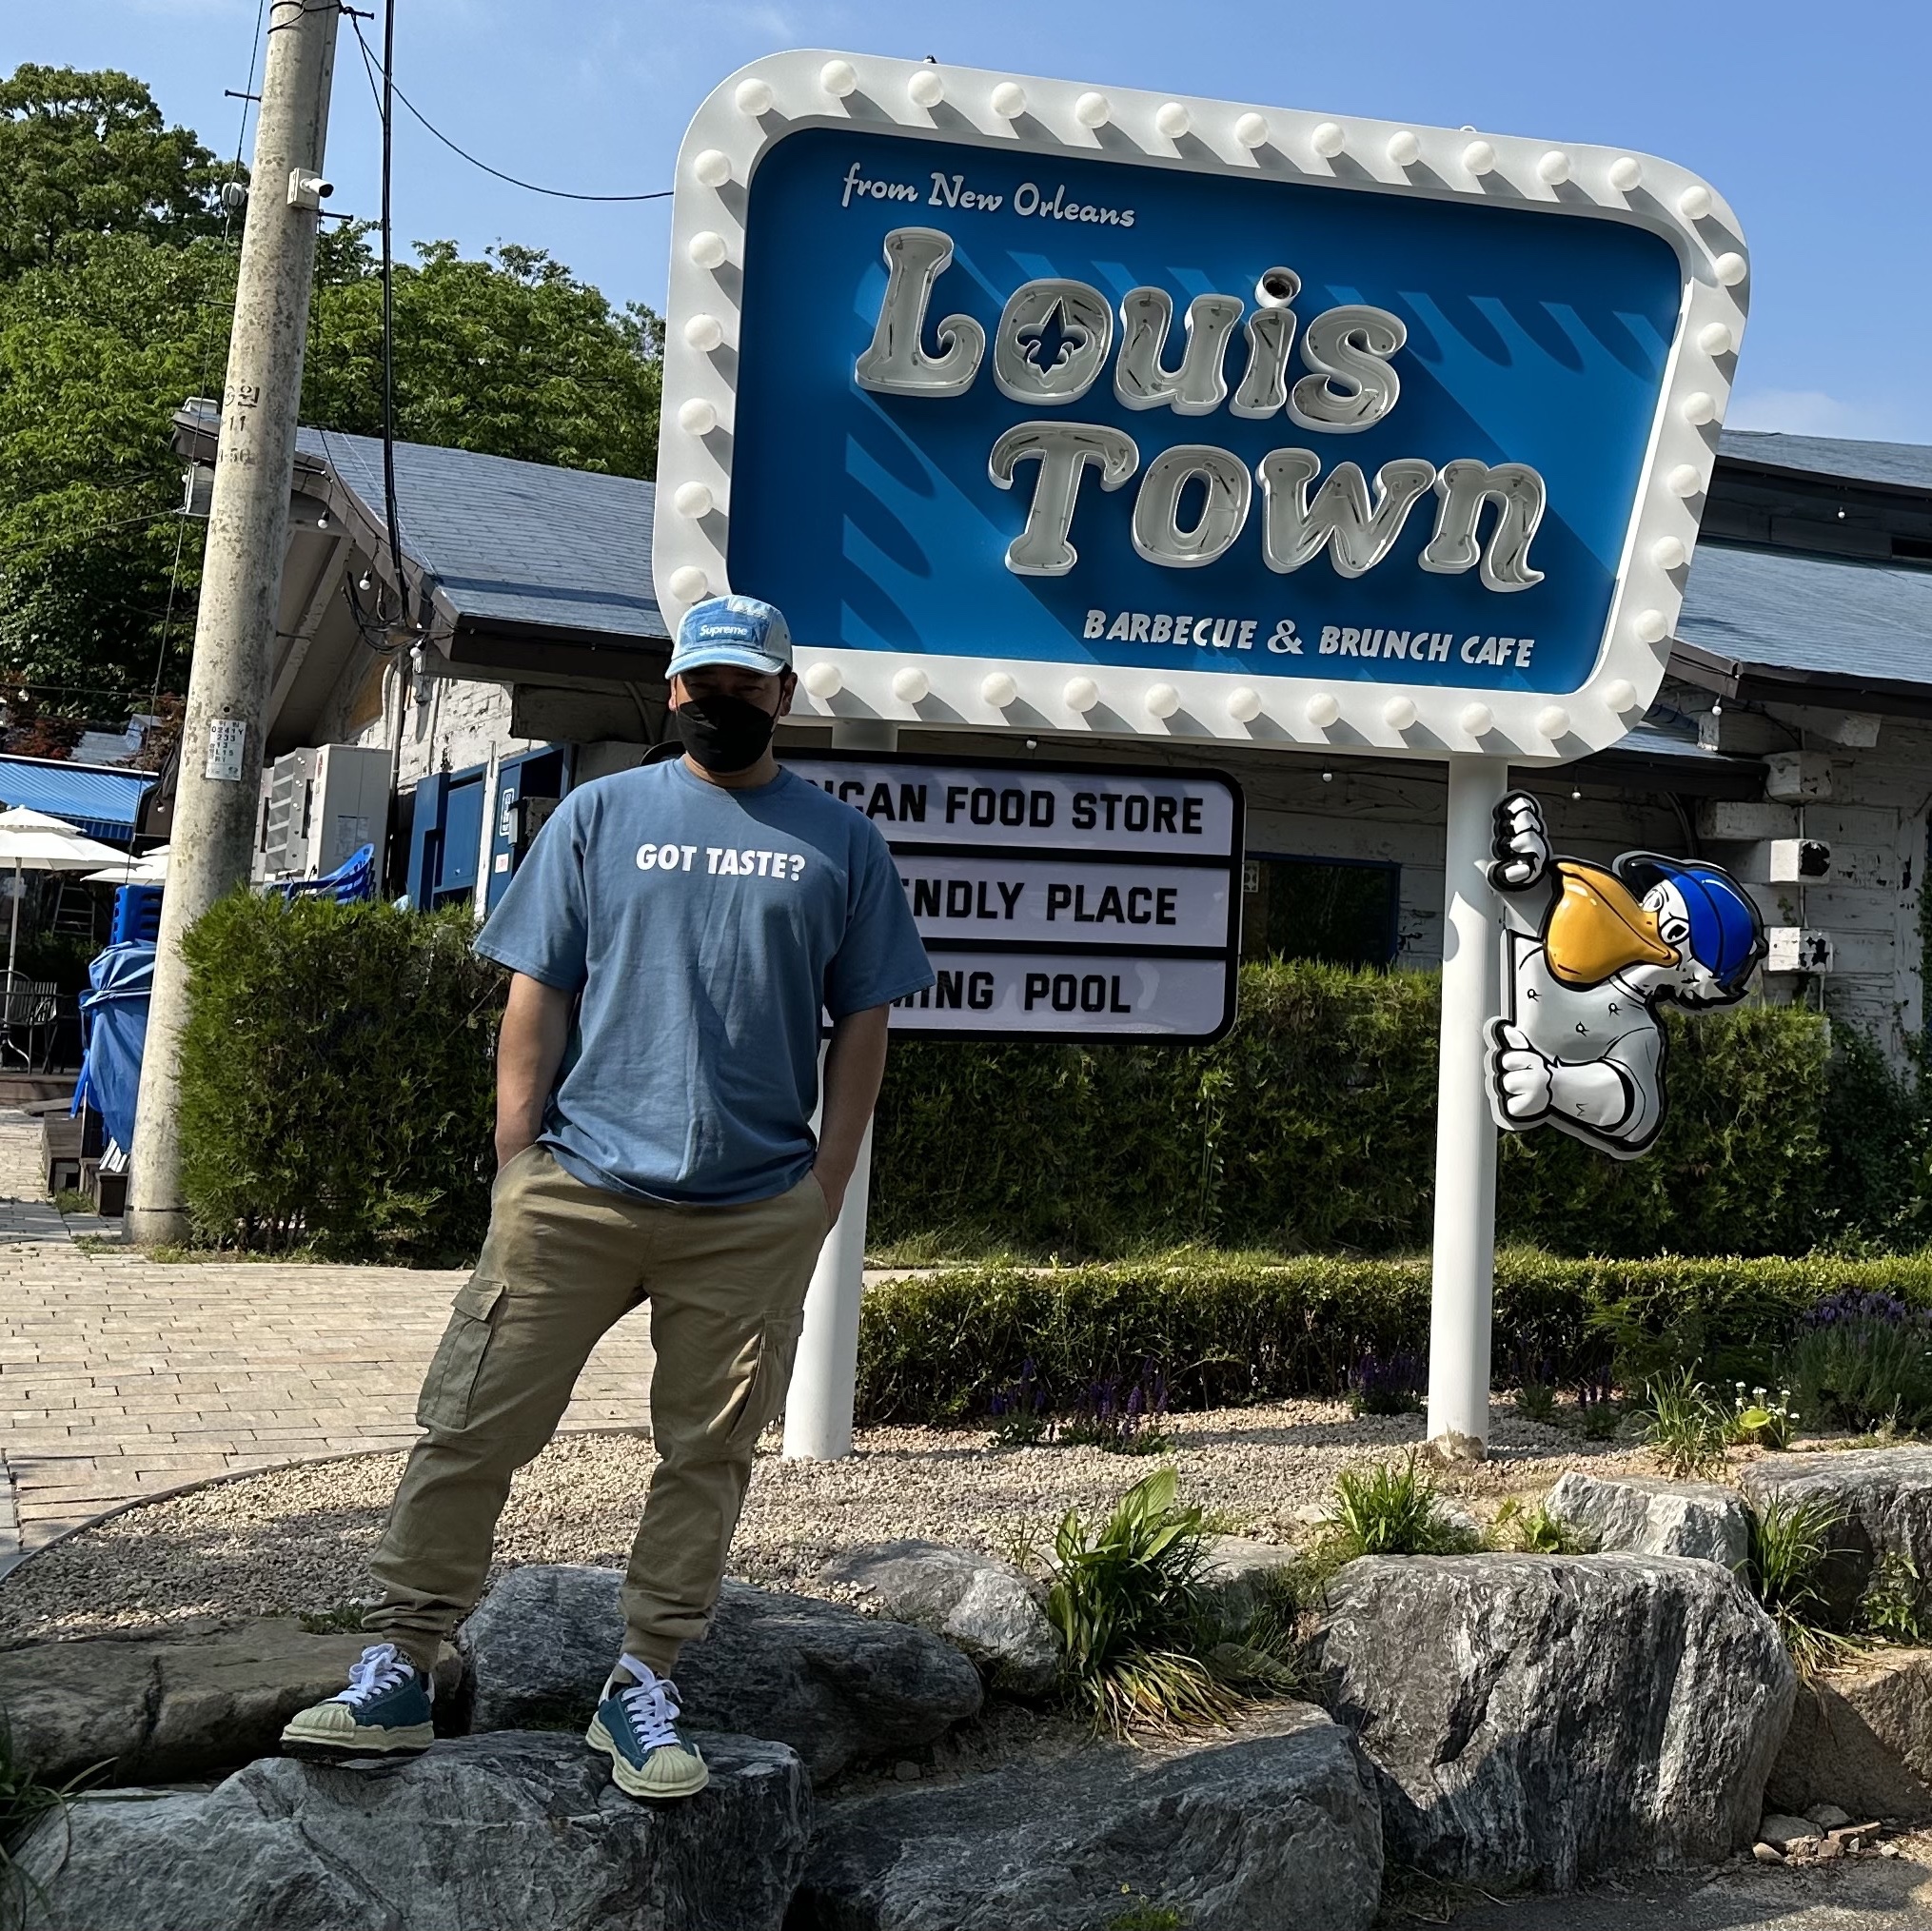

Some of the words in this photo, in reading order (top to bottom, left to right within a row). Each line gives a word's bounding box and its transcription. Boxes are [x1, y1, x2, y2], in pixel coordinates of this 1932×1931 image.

[841, 162, 918, 207] from
[928, 172, 1003, 211] New
[1014, 182, 1135, 227] Orleans
[855, 227, 1408, 433] Louis
[988, 421, 1546, 592] Town
[699, 624, 748, 637] Supreme
[1083, 609, 1258, 650] BARBECUE
[1267, 620, 1304, 655] &
[1318, 625, 1453, 662] BRUNCH
[1460, 636, 1535, 668] CAFE
[804, 779, 927, 822] CAN
[946, 786, 1055, 828] FOOD
[1073, 792, 1203, 834] STORE
[636, 843, 698, 872] GOT
[706, 847, 806, 881] TASTE?
[902, 878, 1025, 919] NDLY
[1047, 883, 1177, 925] PLACE
[1024, 973, 1131, 1014] POOL
